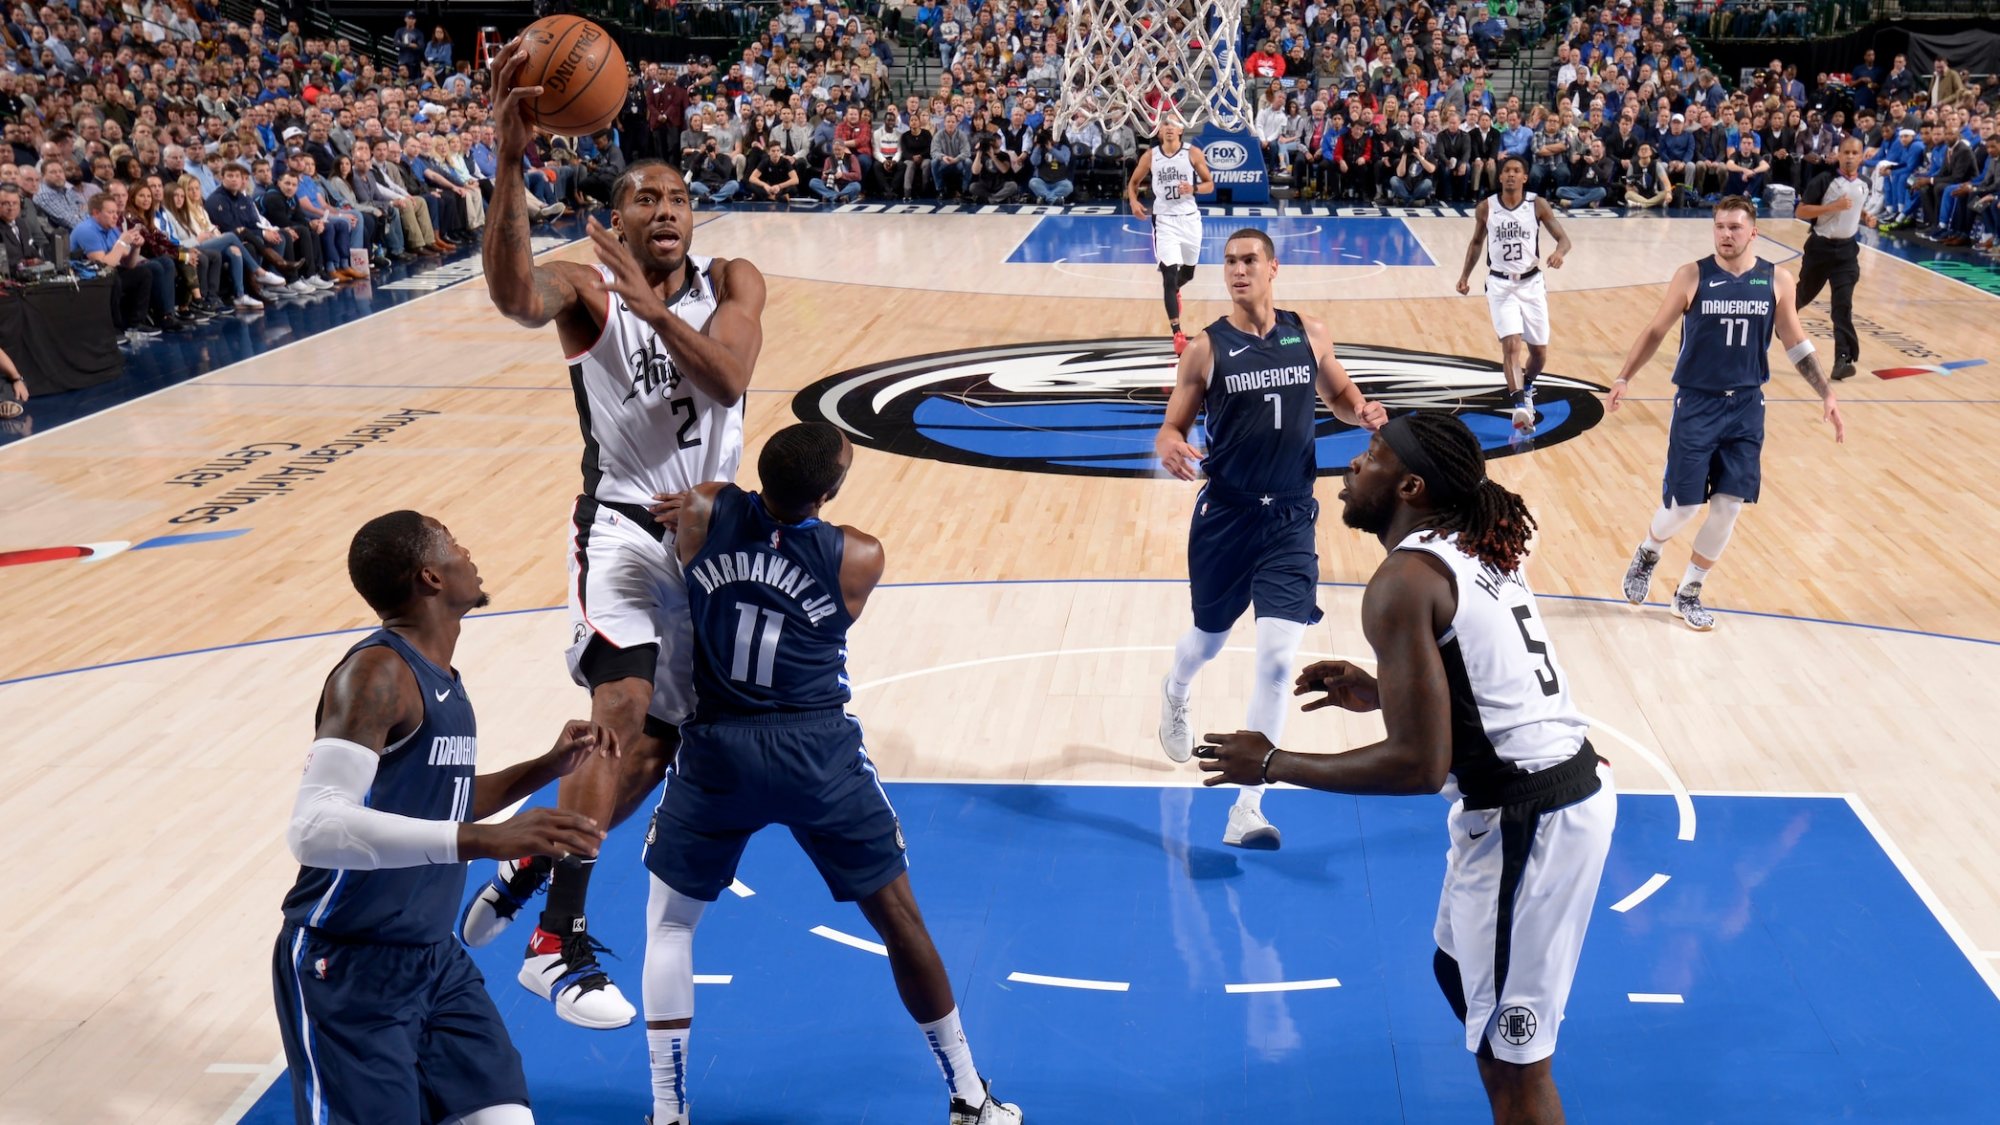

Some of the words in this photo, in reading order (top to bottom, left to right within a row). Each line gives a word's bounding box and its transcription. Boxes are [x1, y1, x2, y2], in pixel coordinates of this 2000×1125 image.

[545, 23, 601, 94] SPALDING
[1212, 147, 1236, 159] FOX
[1157, 170, 1188, 185] Angeles
[1162, 166, 1177, 175] Los
[1198, 170, 1262, 183] THWEST
[1164, 185, 1181, 200] 20
[831, 204, 1117, 215] DALLAS
[1501, 221, 1519, 230] Los
[1492, 226, 1531, 243] Angeles
[1503, 243, 1522, 261] 23
[1749, 278, 1768, 286] chime
[1701, 300, 1769, 315] MAVERICKS
[1280, 336, 1301, 345] chime
[1719, 318, 1750, 347] 77
[1225, 365, 1311, 394] MAVERICKS
[1264, 392, 1282, 429] 7
[670, 396, 702, 450] 2
[164, 441, 302, 488] Center
[692, 551, 816, 600] HARDAWAY
[730, 601, 786, 688] 11
[1511, 604, 1560, 697] 5
[428, 736, 477, 766] MAVERI
